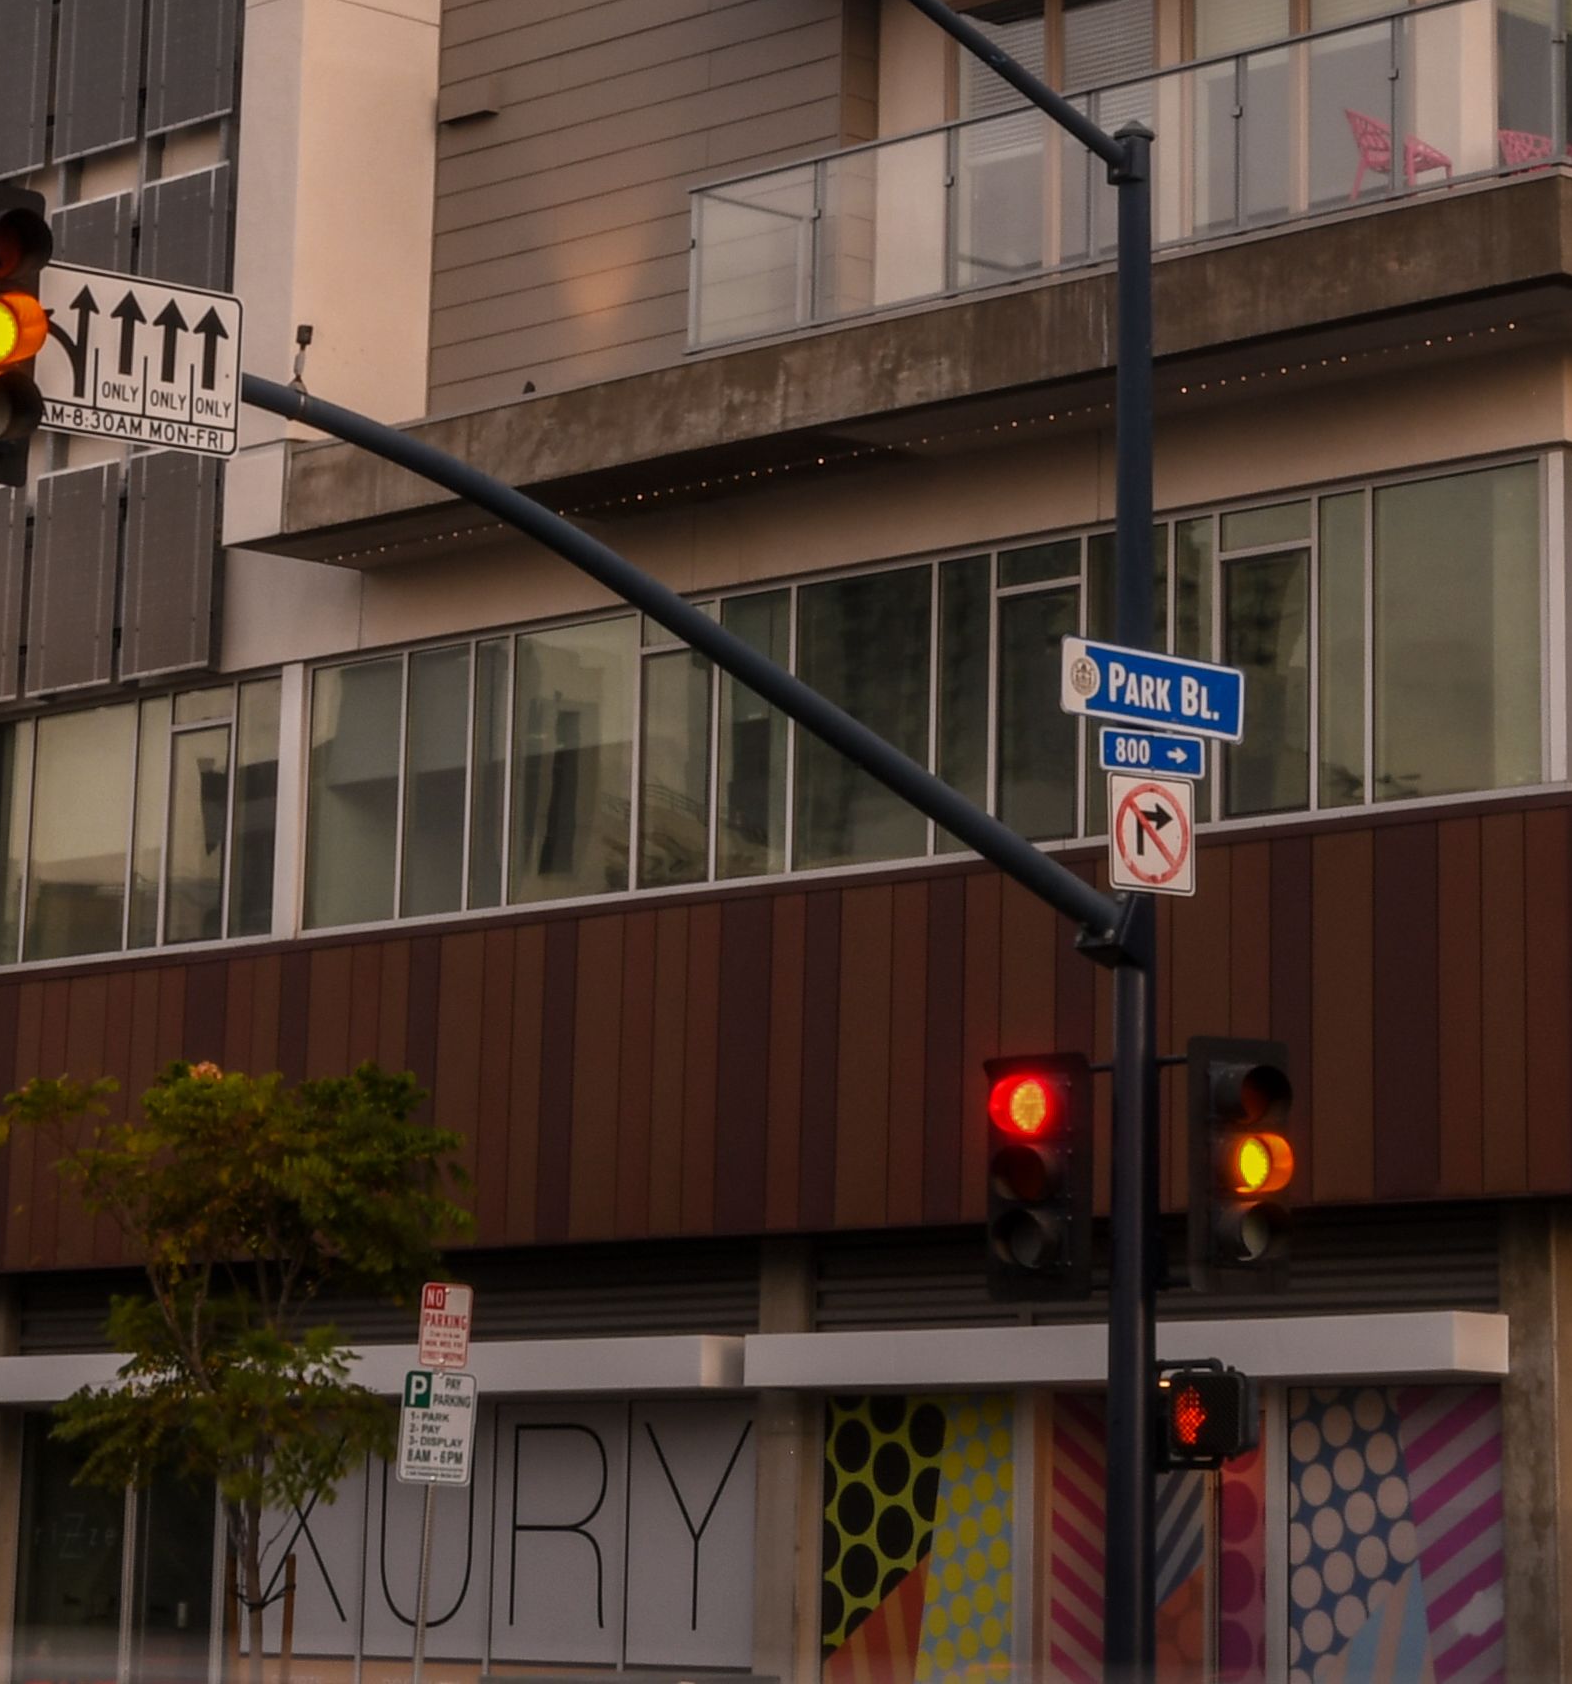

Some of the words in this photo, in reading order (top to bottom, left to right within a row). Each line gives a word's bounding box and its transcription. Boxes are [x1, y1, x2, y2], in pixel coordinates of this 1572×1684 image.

[102, 381, 139, 403] ONLY
[150, 389, 187, 411] ONLY
[195, 397, 231, 418] ONLY
[149, 423, 225, 450] MON-FRI
[1115, 736, 1151, 764] 800
[427, 1288, 443, 1308] NO
[425, 1312, 467, 1330] PARKING
[409, 1374, 428, 1406] P
[445, 1377, 462, 1391] PAY
[432, 1393, 471, 1409] PARKING
[421, 1412, 450, 1423] PARK
[421, 1423, 441, 1435] PAY
[420, 1436, 464, 1449] DISPLAY
